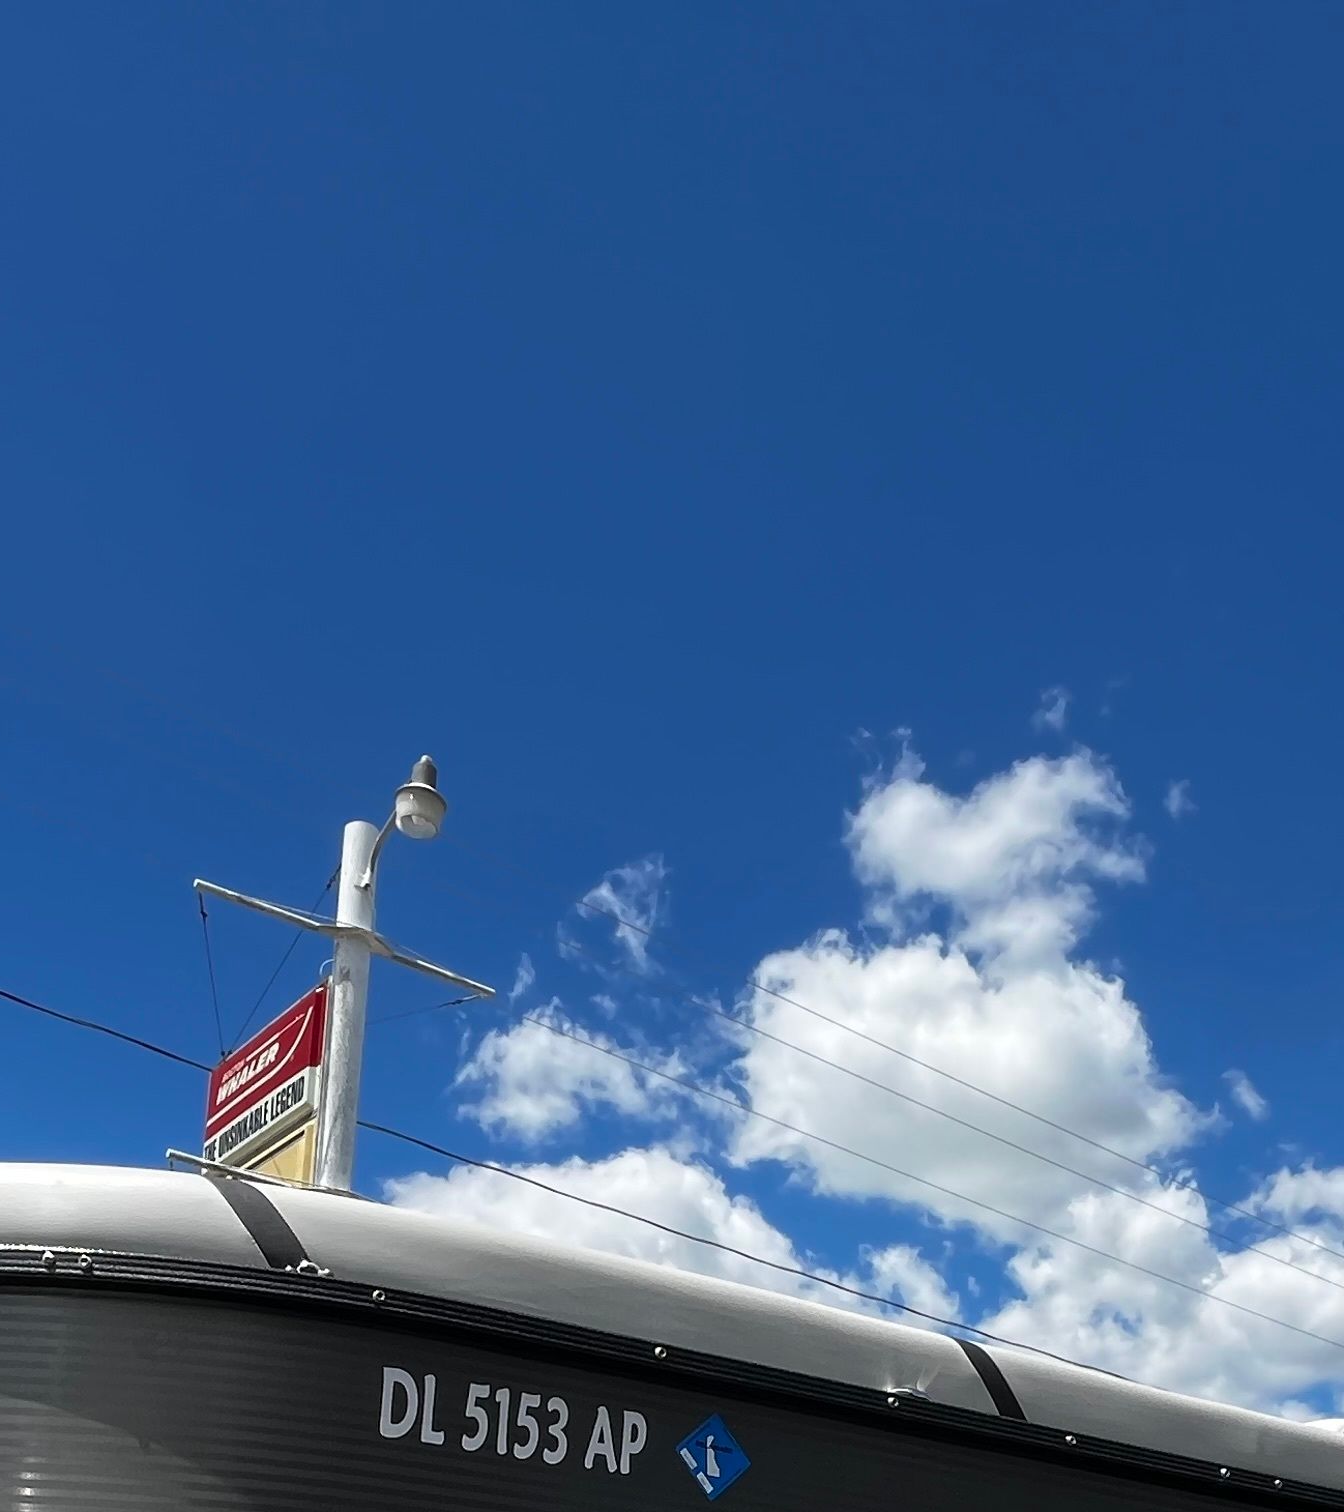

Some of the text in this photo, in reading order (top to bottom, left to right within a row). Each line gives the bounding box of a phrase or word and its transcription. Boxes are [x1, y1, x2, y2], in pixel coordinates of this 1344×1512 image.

[216, 1042, 280, 1106] WHALER
[218, 1101, 269, 1157] UNSINKABLE
[271, 1075, 305, 1121] LEGEND
[379, 1366, 647, 1474] DL 5153 AP
